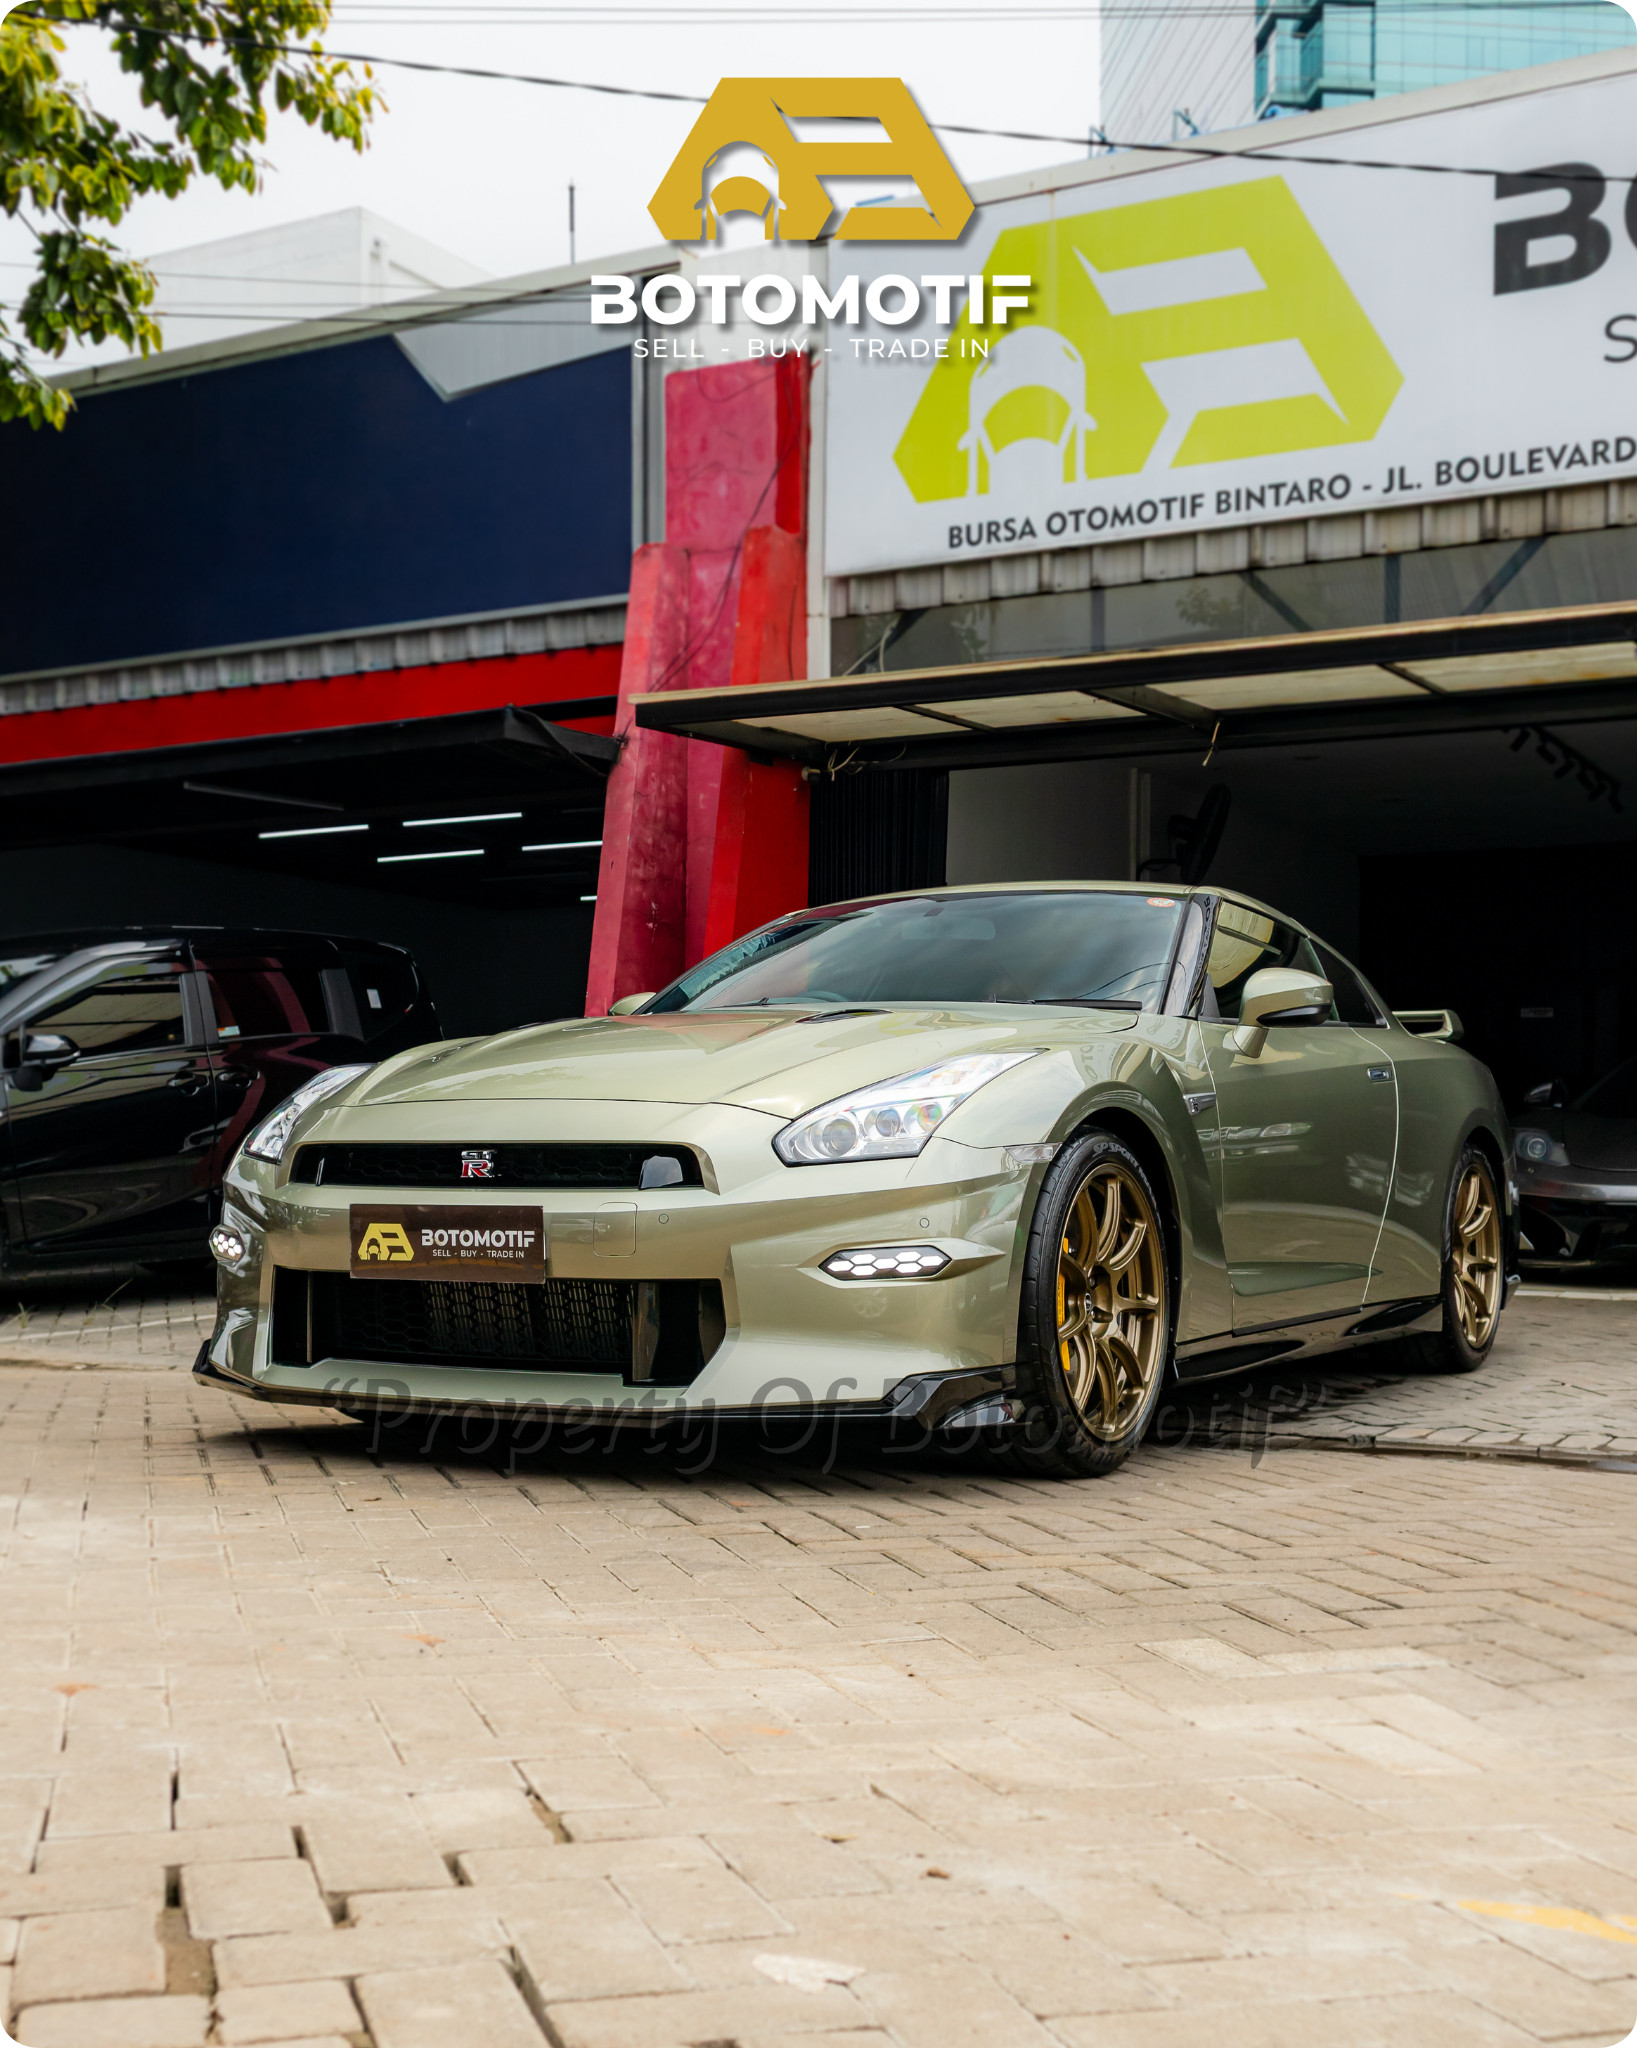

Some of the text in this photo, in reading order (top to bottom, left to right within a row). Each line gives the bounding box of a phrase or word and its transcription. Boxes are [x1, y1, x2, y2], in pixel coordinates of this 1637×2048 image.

[1493, 162, 1637, 296] B
[948, 516, 1037, 548] BURSA
[1046, 493, 1206, 536] OTOMOTIF
[1216, 473, 1352, 515] BINTARO
[1383, 466, 1422, 495] JL.
[1435, 435, 1636, 486] BOULEVARD
[421, 1229, 535, 1247] BOTOMOTIF
[432, 1249, 452, 1258] SELL
[460, 1249, 477, 1258] BUY
[487, 1249, 513, 1258] TRADE
[515, 1249, 524, 1259] IN
